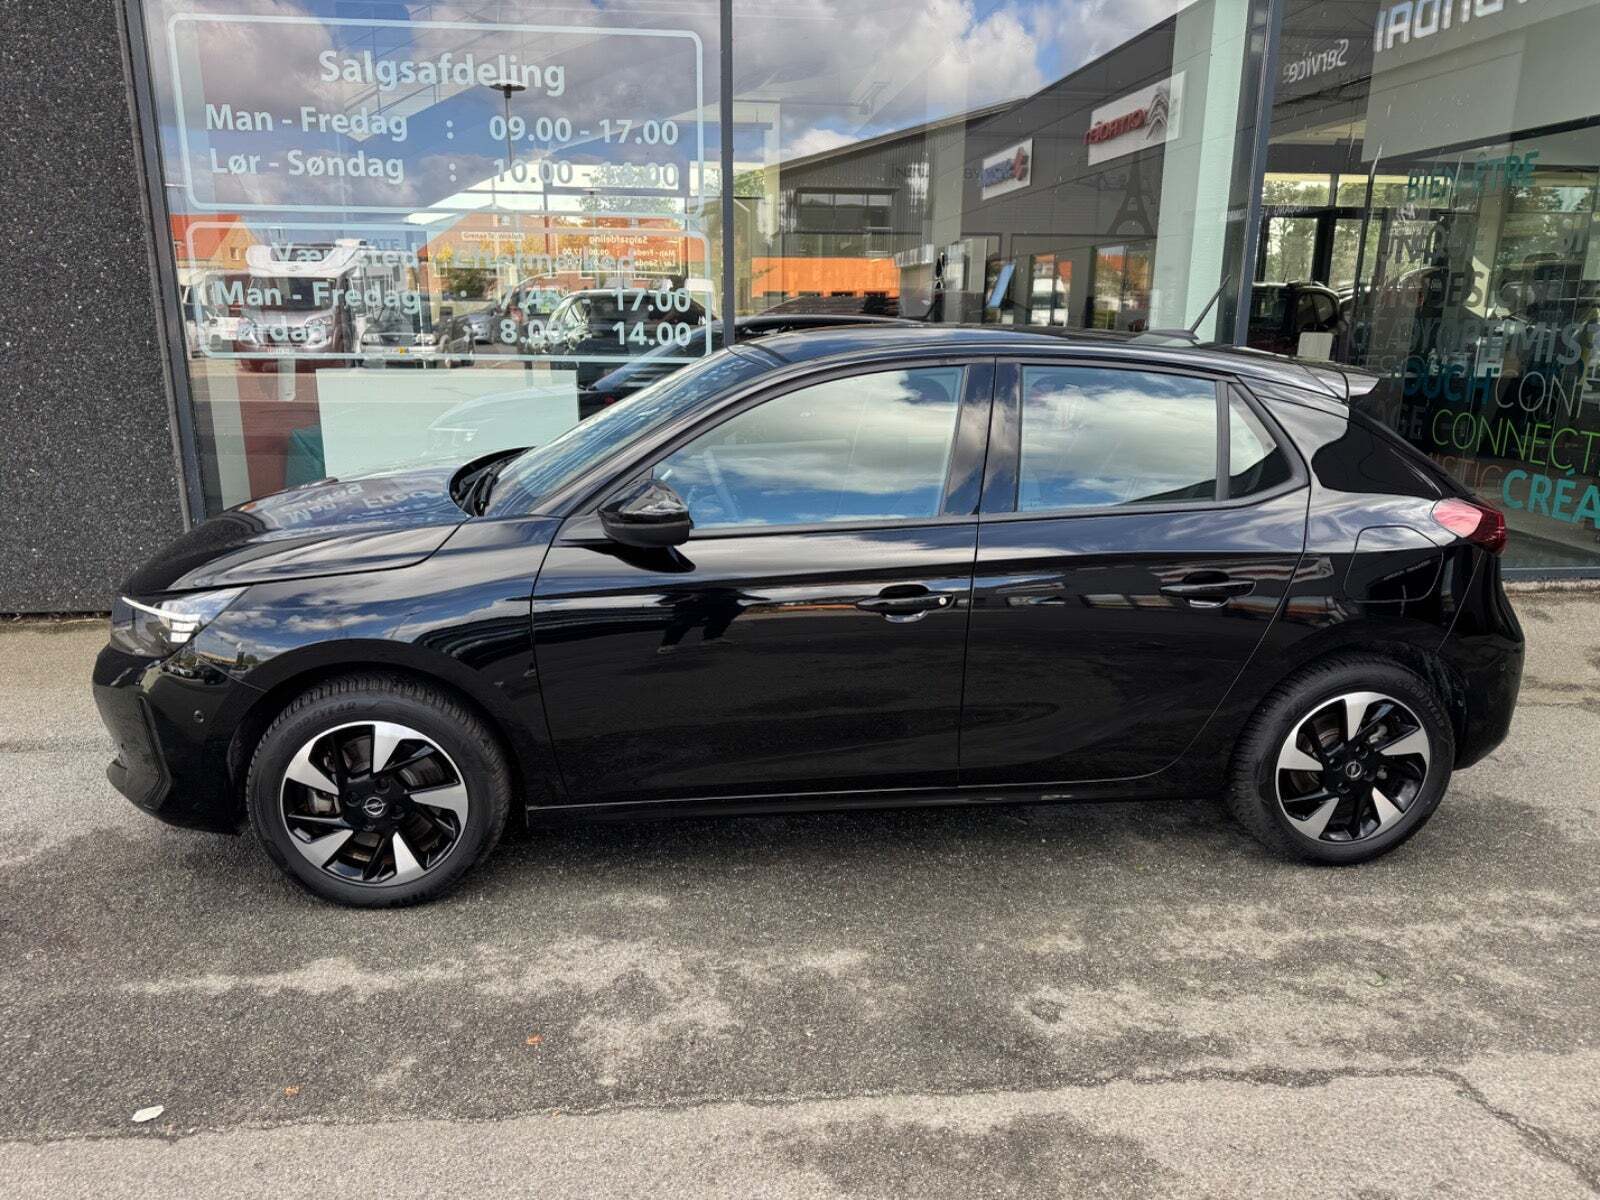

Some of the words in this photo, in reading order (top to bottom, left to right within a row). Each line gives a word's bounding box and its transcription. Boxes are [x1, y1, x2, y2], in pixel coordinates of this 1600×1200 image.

[319, 50, 566, 97] Salgsafdeling
[205, 103, 274, 131] Man
[301, 106, 408, 142] Fredag
[489, 115, 573, 142] 09.00
[599, 118, 679, 145] 17.00
[210, 148, 261, 174] Lør
[287, 149, 404, 184] Søndag
[494, 158, 574, 184] 10.00
[213, 280, 283, 306] Man
[312, 280, 421, 315] Fredag
[610, 287, 691, 313] 17.00
[612, 320, 693, 347] 14.00
